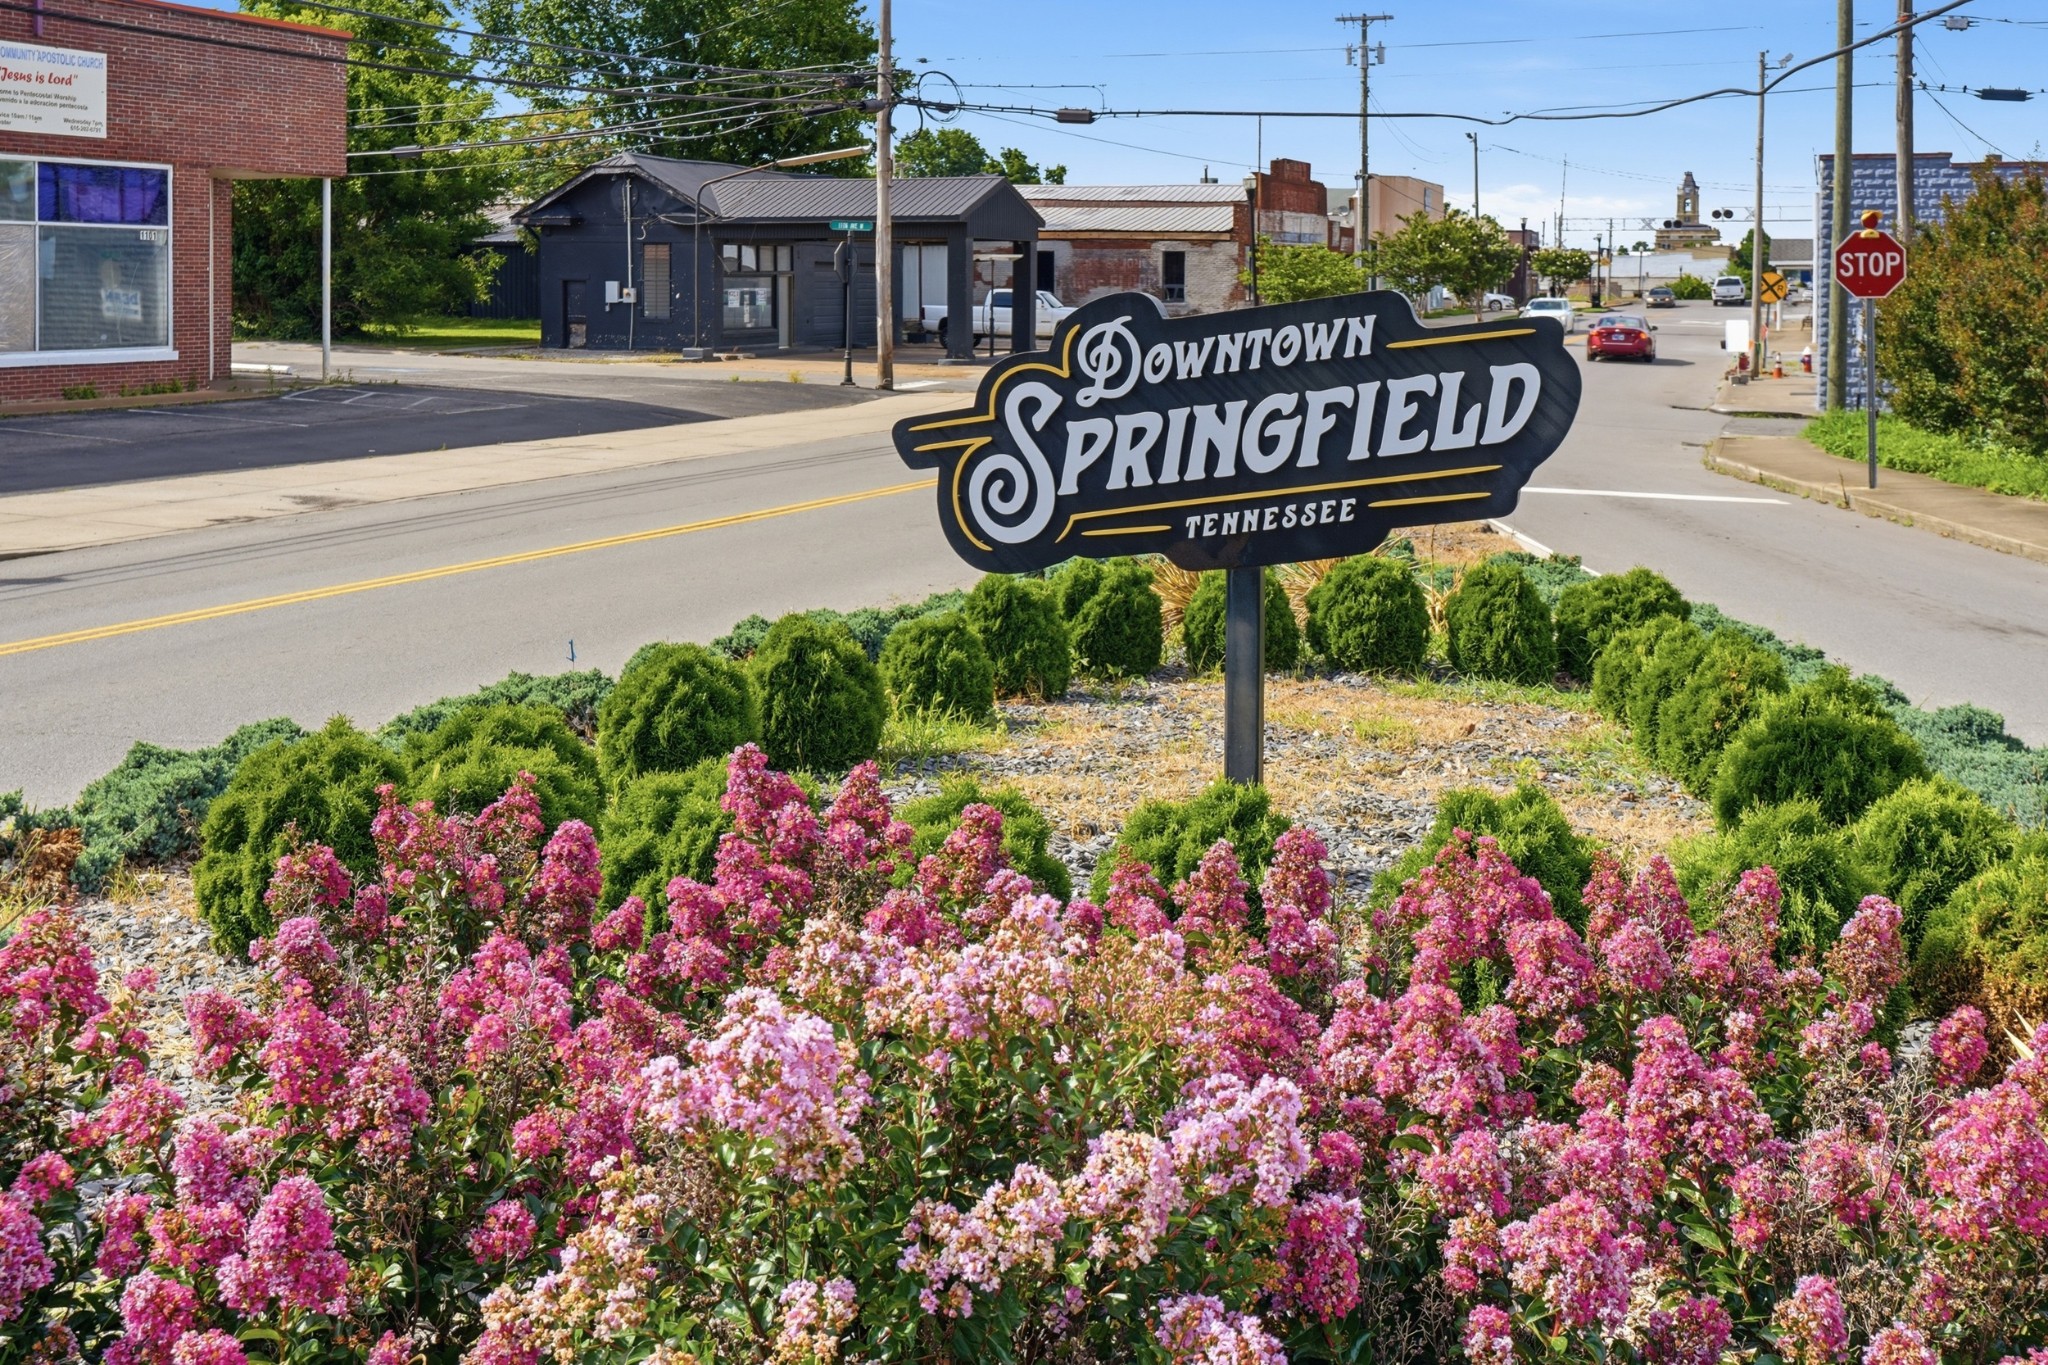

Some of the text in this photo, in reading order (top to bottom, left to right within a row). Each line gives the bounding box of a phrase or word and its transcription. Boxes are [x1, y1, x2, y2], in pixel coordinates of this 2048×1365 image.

[37, 50, 76, 67] APOSTOLIC
[77, 56, 104, 70] CHURCH
[35, 71, 44, 84] is
[20, 90, 53, 99] Pentecostal
[53, 93, 77, 102] Worship
[1839, 251, 1901, 277] STOP
[1075, 314, 1377, 408] DOWNTOWN
[968, 361, 1542, 544] SPRINGFIELD
[1184, 498, 1358, 539] TENNESSEE
